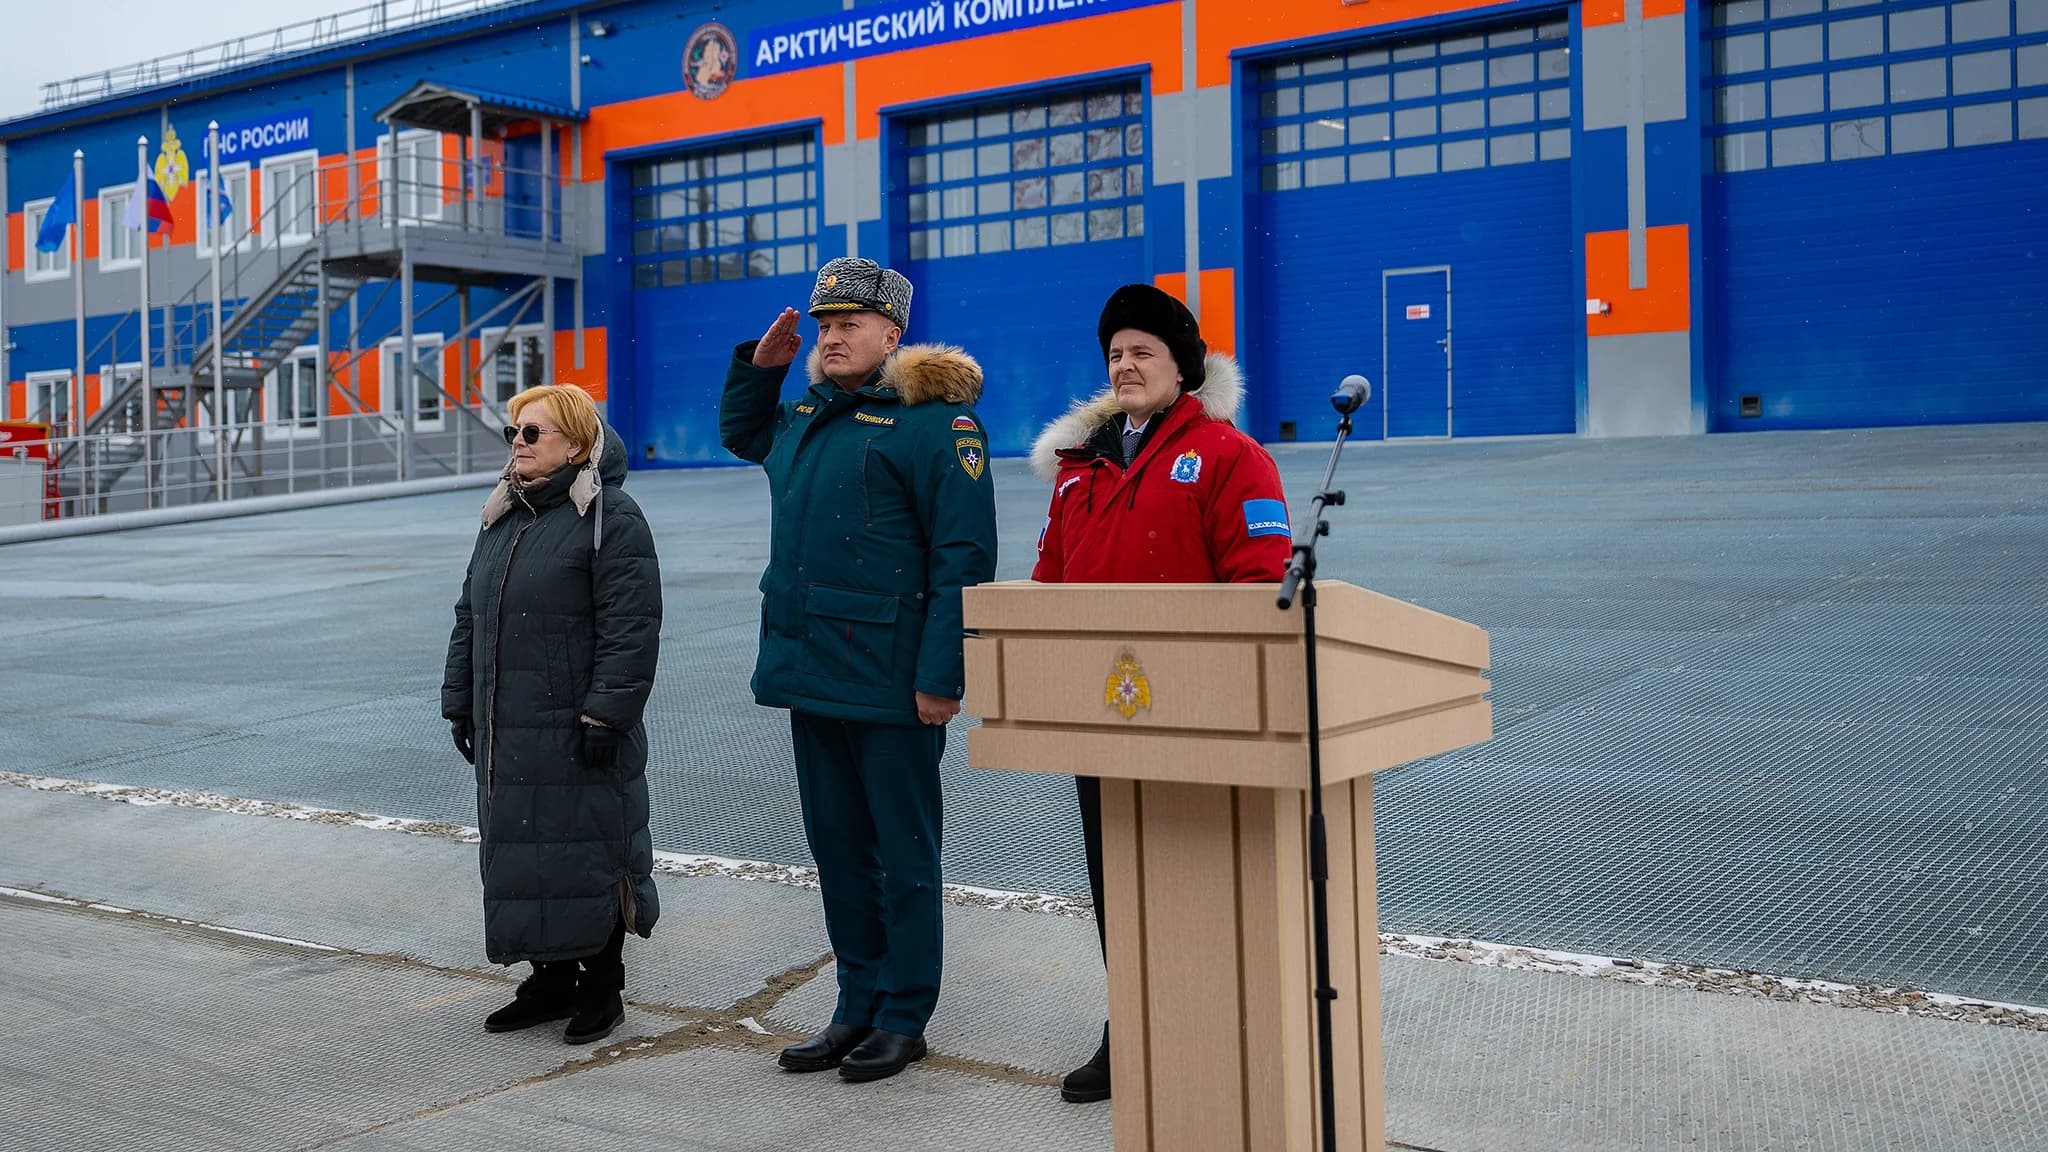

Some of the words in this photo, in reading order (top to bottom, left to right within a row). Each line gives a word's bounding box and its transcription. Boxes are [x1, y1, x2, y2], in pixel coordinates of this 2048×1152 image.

[755, 0, 945, 67] АРКТИЧЕСКИЙ
[953, 0, 1109, 29] КОМП
[241, 116, 309, 151] РОССИИ
